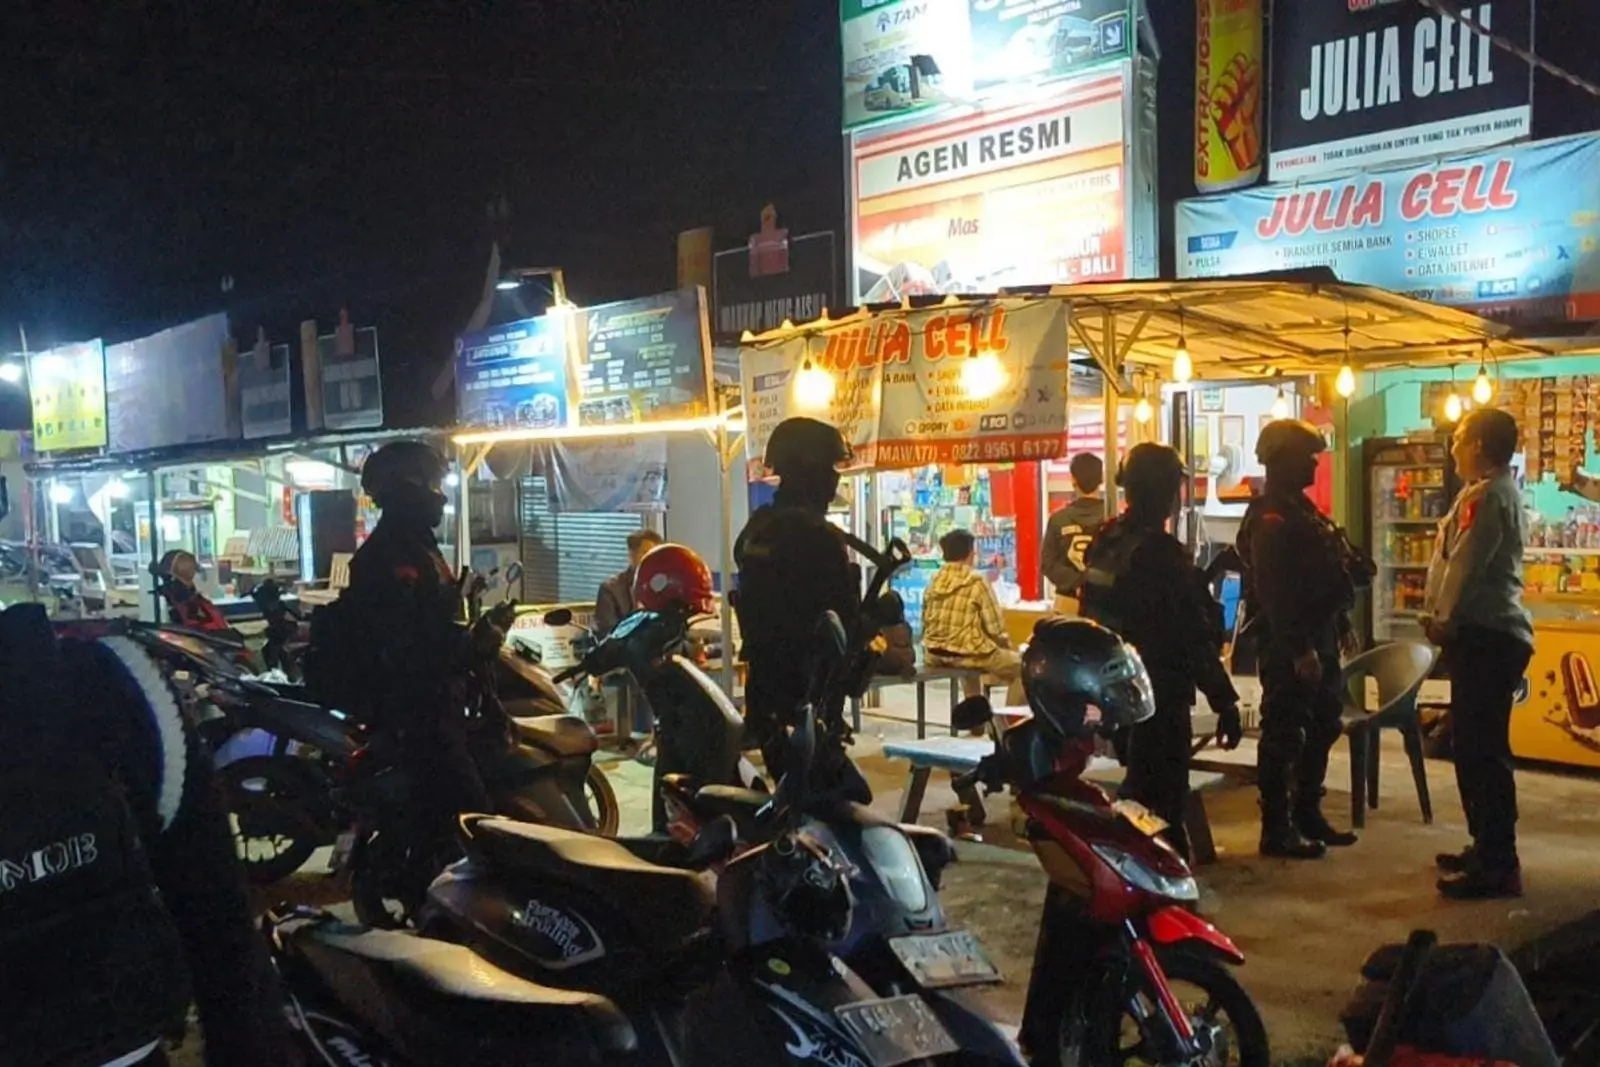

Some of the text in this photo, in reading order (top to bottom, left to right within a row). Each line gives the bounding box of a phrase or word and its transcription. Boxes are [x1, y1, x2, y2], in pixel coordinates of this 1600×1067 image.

[1300, 4, 1494, 121] JULIA CELL
[897, 116, 1072, 182] AGEN RESMI
[948, 216, 979, 238] Mas
[1256, 159, 1516, 238] JULIA CELL
[1330, 238, 1364, 253] SEMUA
[1366, 235, 1393, 249] BANK
[1417, 226, 1457, 242] SHOPEE
[816, 307, 1008, 370] JULIA CELL
